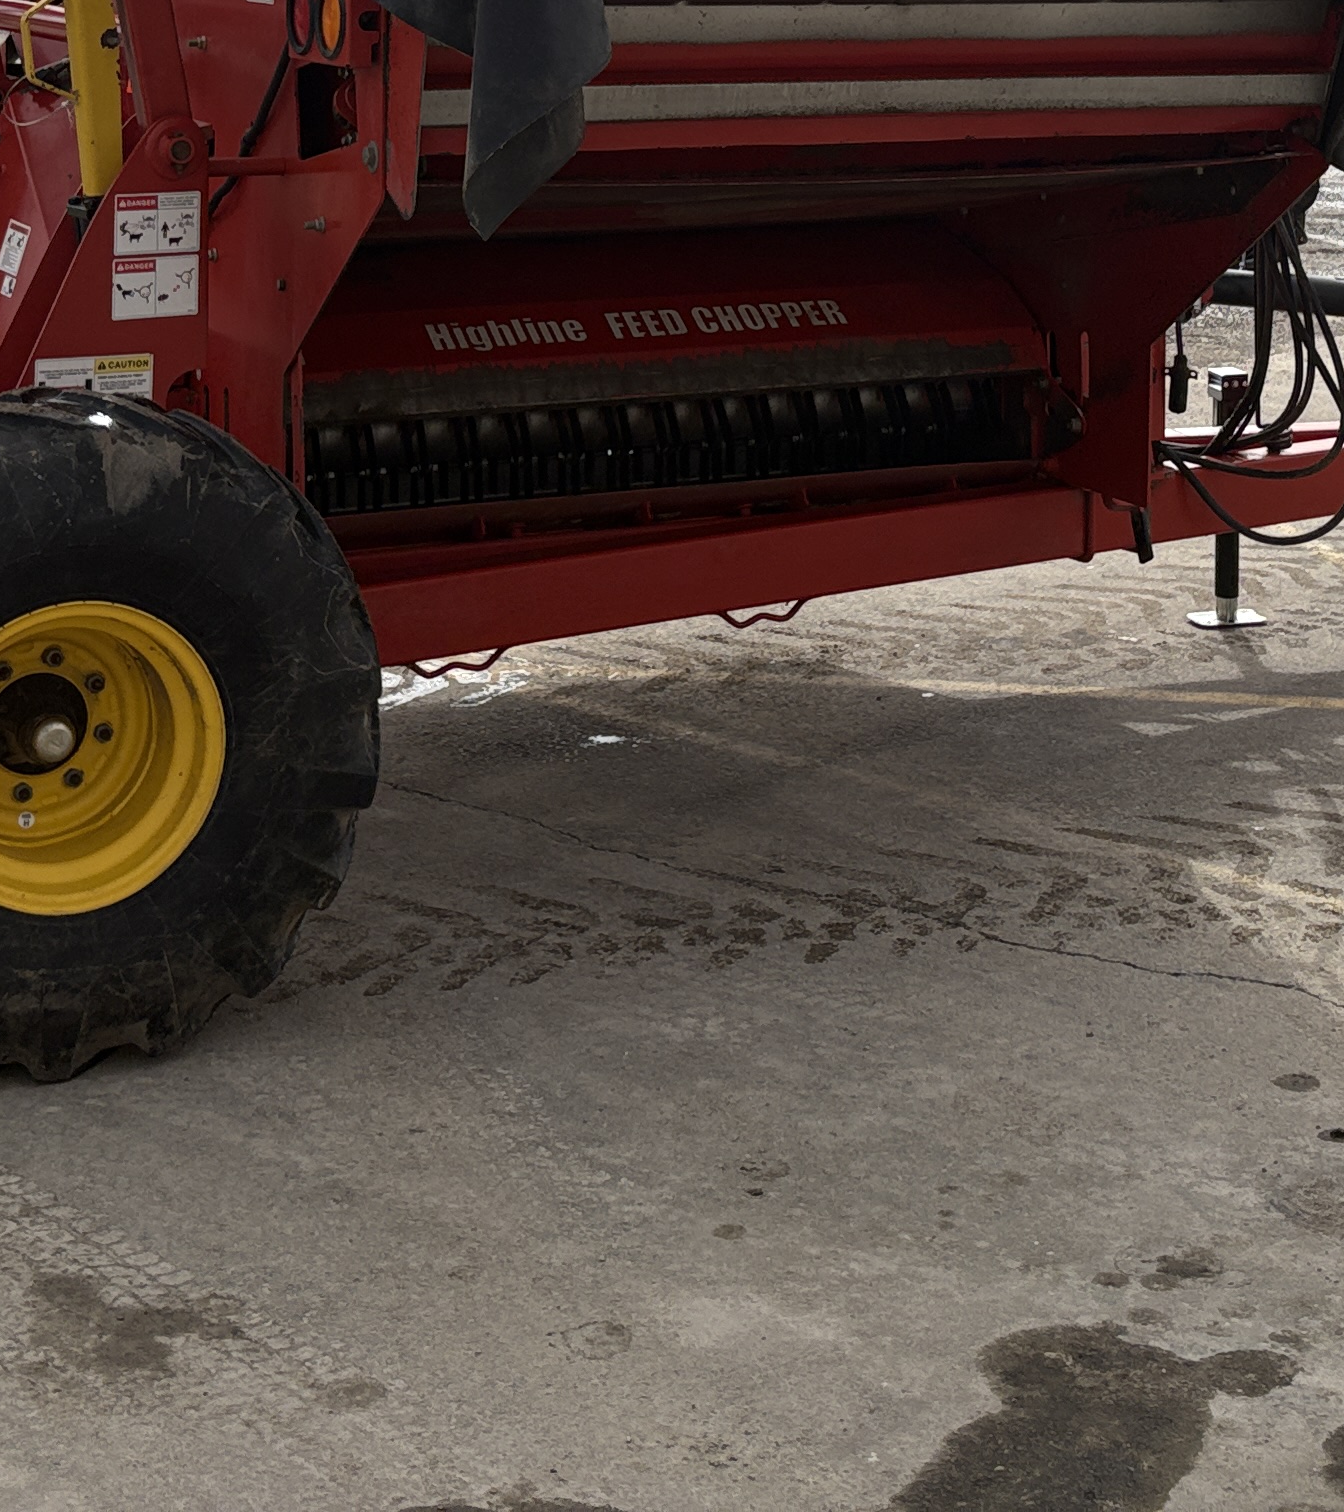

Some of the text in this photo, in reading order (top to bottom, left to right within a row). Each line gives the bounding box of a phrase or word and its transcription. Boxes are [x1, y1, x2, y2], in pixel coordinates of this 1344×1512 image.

[126, 198, 156, 208] DANGER
[124, 261, 154, 271] DANGER
[424, 299, 849, 352] Highline FEED CHOPPER
[107, 359, 150, 370] CAUTION
